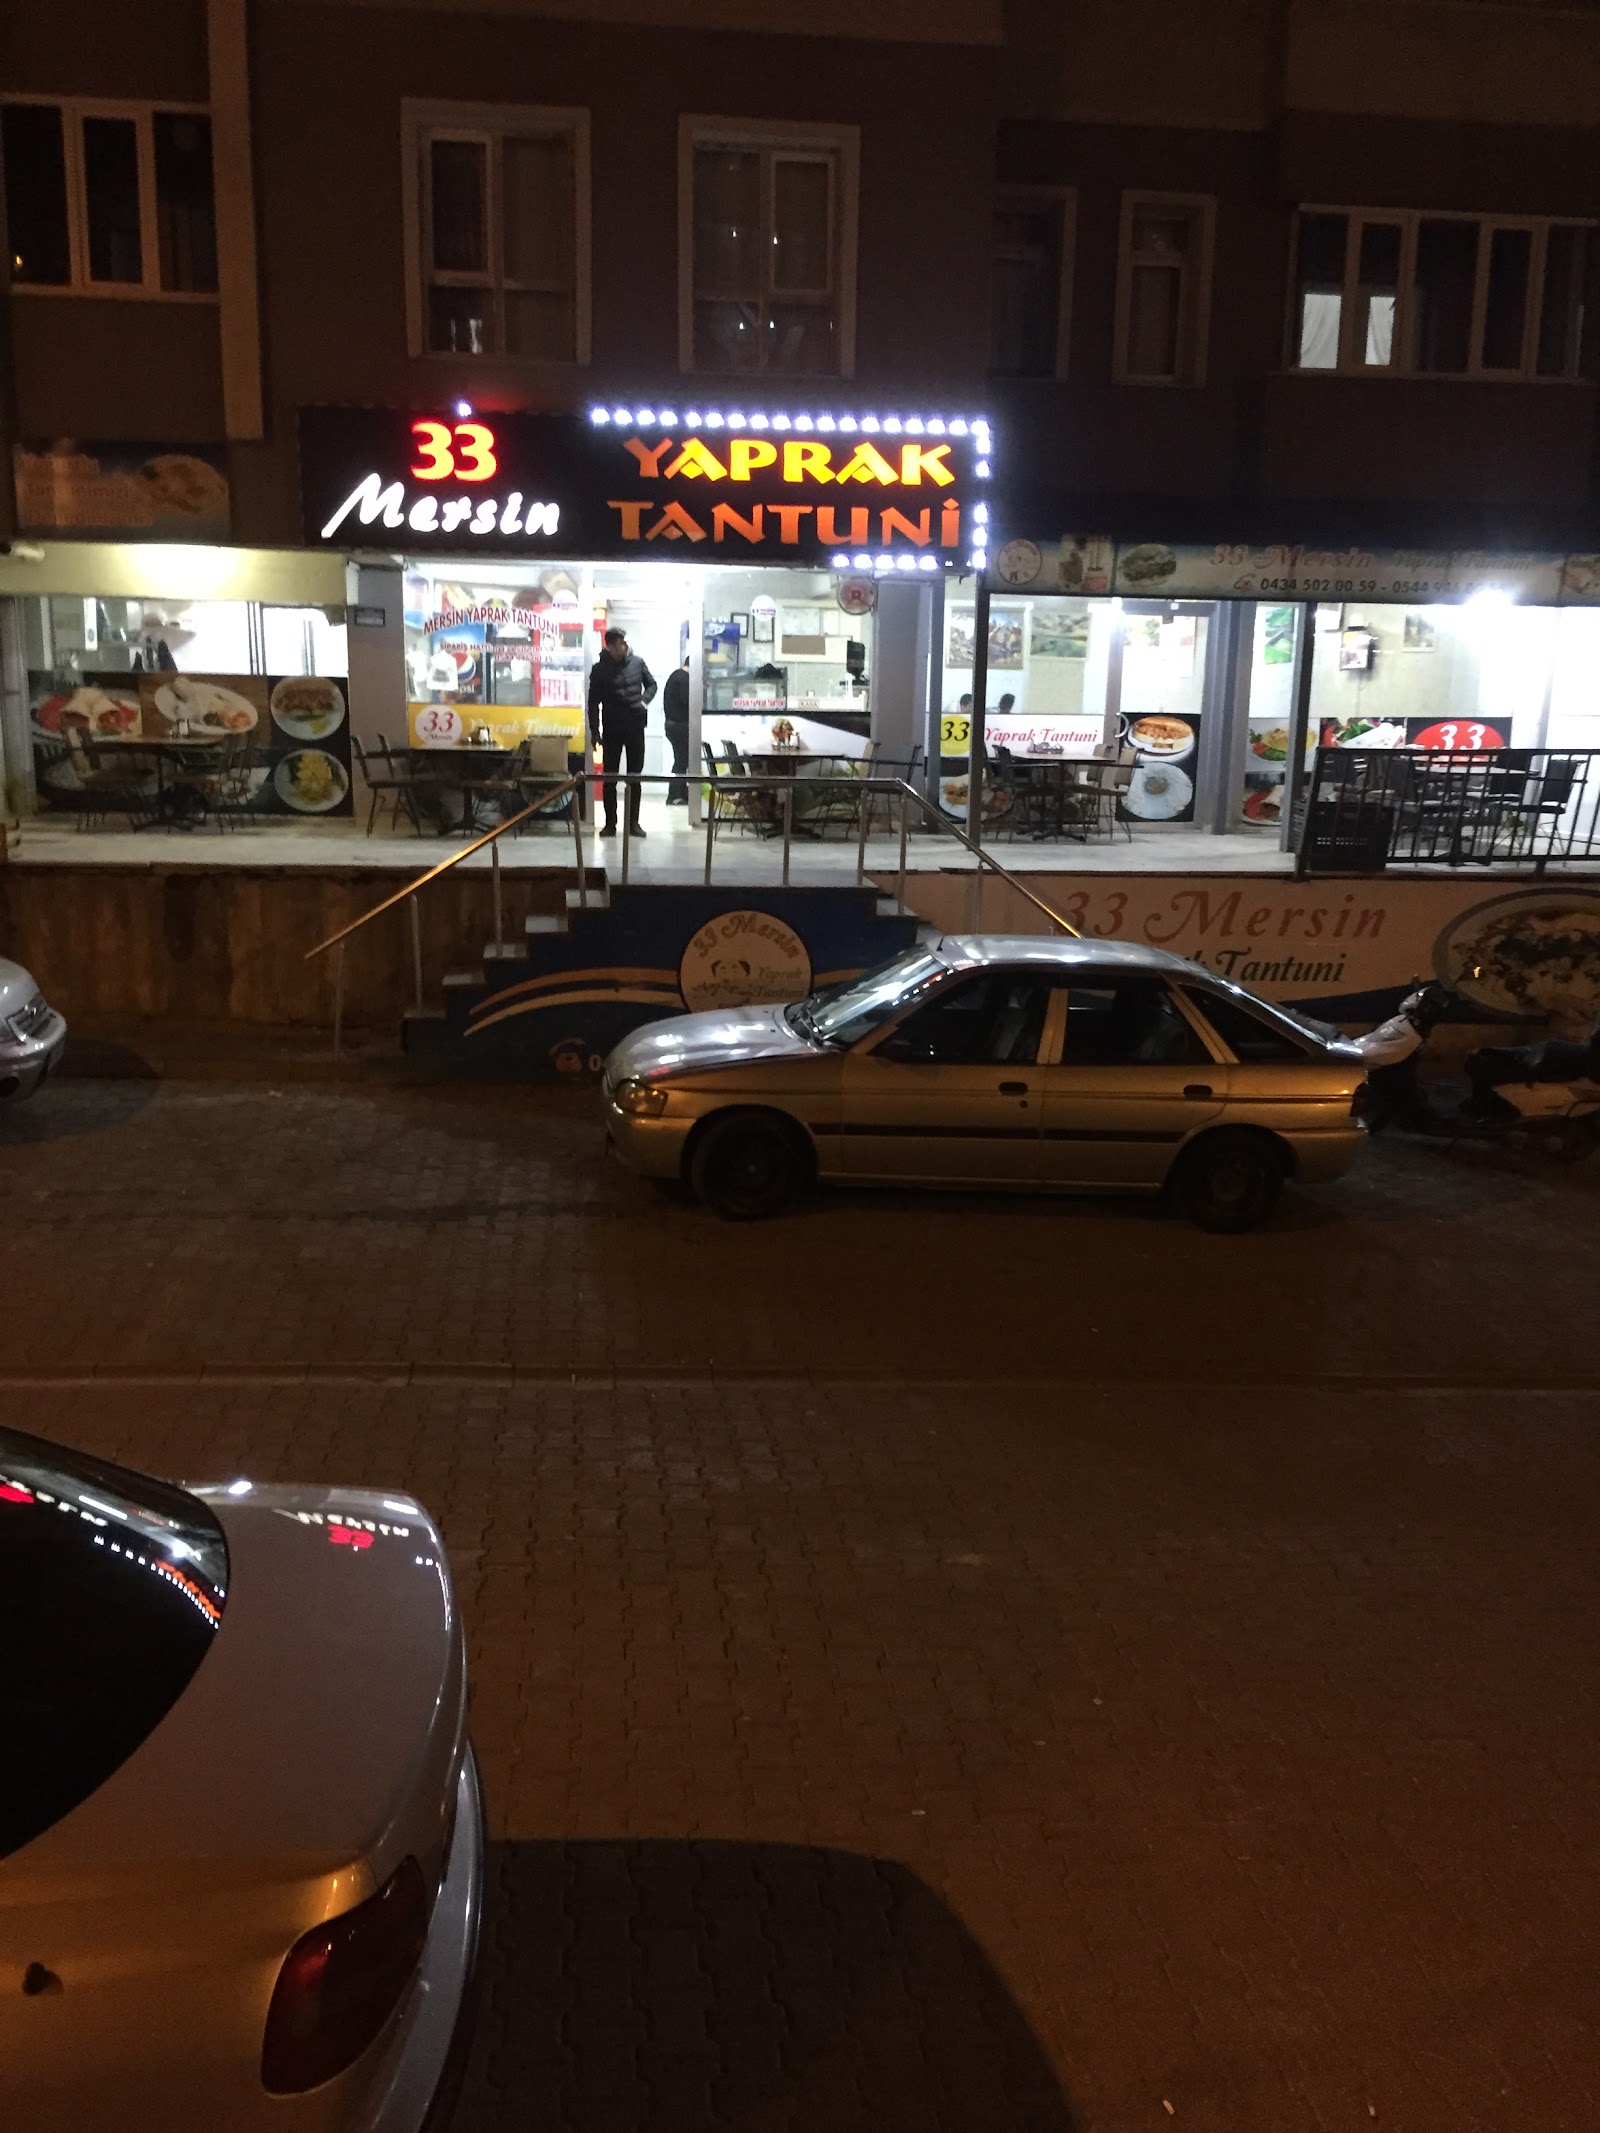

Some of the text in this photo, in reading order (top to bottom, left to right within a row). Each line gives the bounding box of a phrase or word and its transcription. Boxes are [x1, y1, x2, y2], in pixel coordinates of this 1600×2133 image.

[411, 421, 498, 482] 33
[623, 437, 956, 487] YAPRAK
[320, 472, 561, 539] Mersin
[1210, 544, 1248, 567] 33
[1252, 545, 1374, 569] Mersin
[1260, 578, 1297, 591] 0434
[1302, 579, 1330, 592] 502
[1335, 580, 1353, 592] 00
[1358, 580, 1377, 592] 59
[1391, 580, 1429, 593] 0544
[467, 607, 509, 622] YAPRAK
[423, 710, 454, 733] 33
[940, 721, 970, 741] 33
[984, 727, 1098, 746] Yaprak Tantuni
[1432, 724, 1486, 750] 33
[1052, 890, 1386, 943] 33 Mersin
[694, 914, 799, 958] 33 Mersin
[1214, 947, 1347, 983] Tantuni
